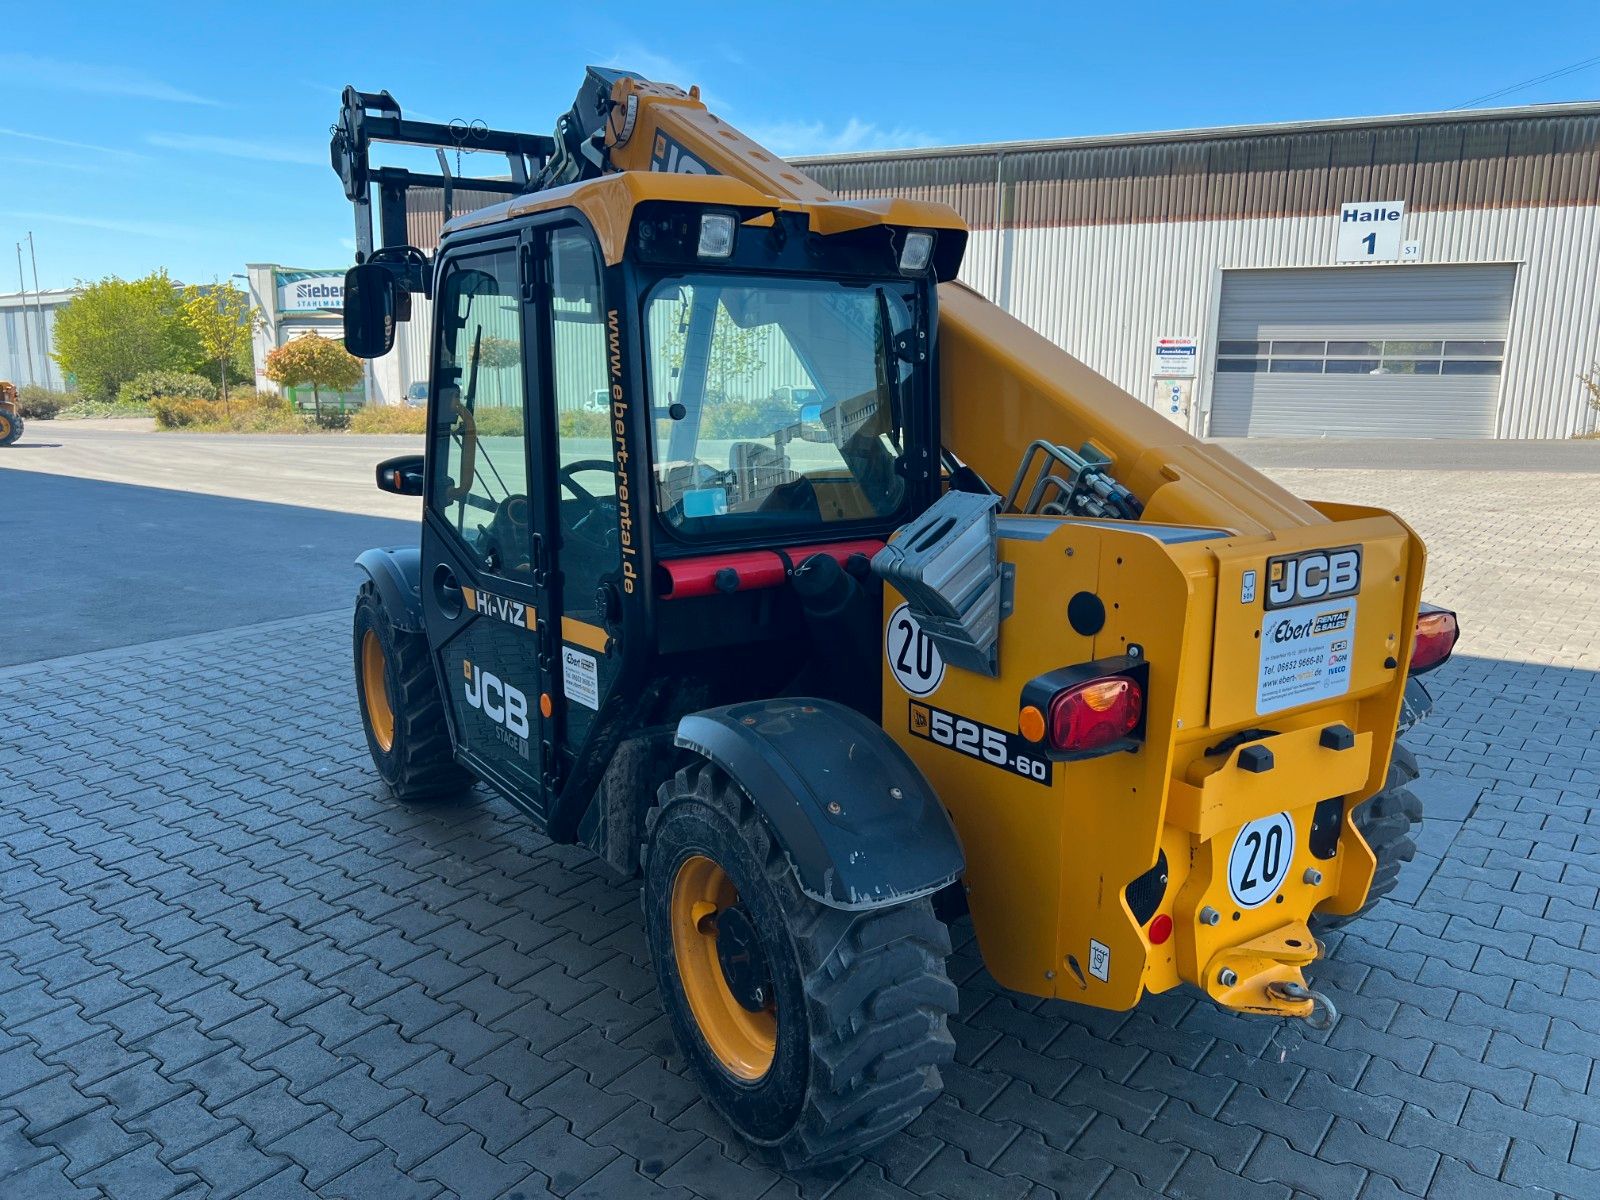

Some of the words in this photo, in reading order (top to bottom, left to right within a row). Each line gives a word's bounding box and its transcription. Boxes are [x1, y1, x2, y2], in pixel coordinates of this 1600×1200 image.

[1343, 208, 1400, 222] Halle
[1362, 232, 1376, 254] 1
[607, 309, 637, 594] www.ebert-rental.de
[1270, 551, 1358, 604] JCB
[1317, 611, 1348, 624] RENTAL
[1321, 621, 1346, 631] SALES
[1275, 619, 1313, 643] Ebert
[896, 619, 934, 680] 20
[1331, 641, 1347, 651] JCB
[1264, 666, 1275, 675] Tel.
[1328, 666, 1345, 675] IVECO
[464, 665, 529, 739] JCB
[1240, 825, 1282, 891] 20
